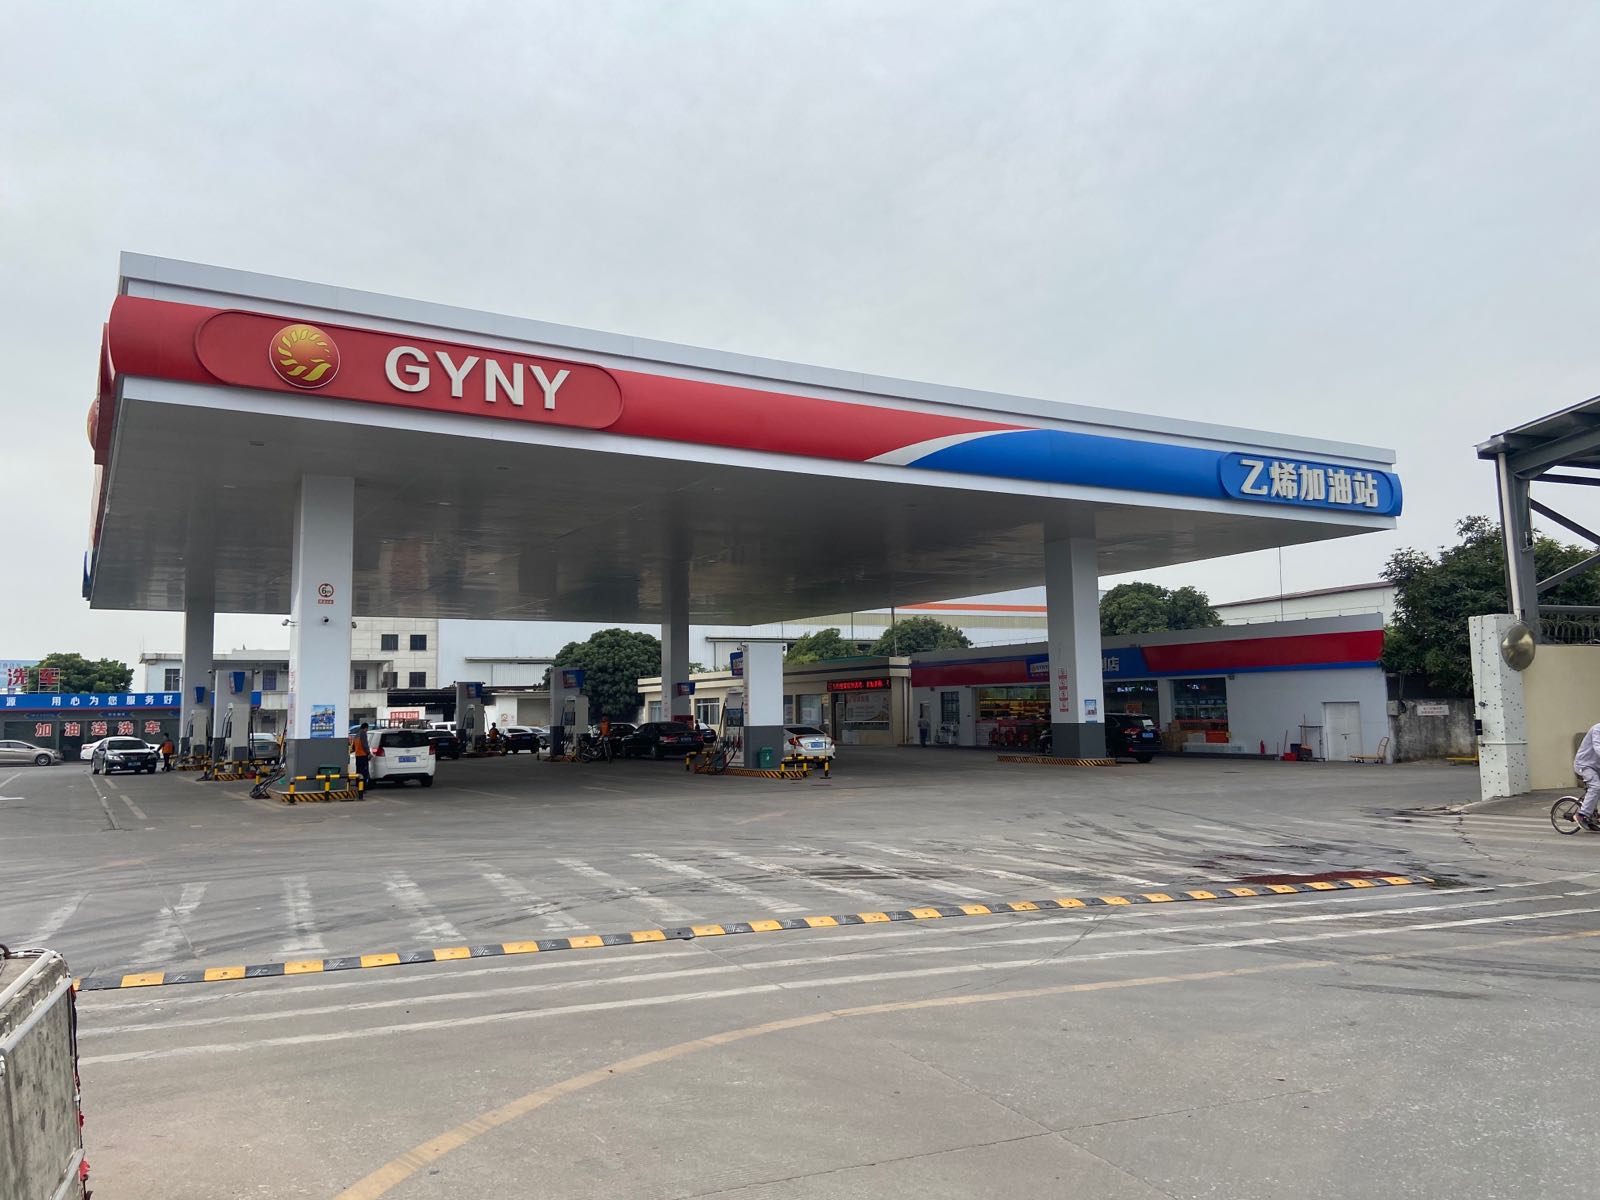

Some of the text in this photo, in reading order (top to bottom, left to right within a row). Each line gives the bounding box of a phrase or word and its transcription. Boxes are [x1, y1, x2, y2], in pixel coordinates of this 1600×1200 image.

[384, 345, 571, 410] GYNY
[1240, 459, 1379, 508] 乙烯加油站
[51, 694, 173, 707] 用心为您服务好
[35, 720, 161, 737] 加油送洗车
